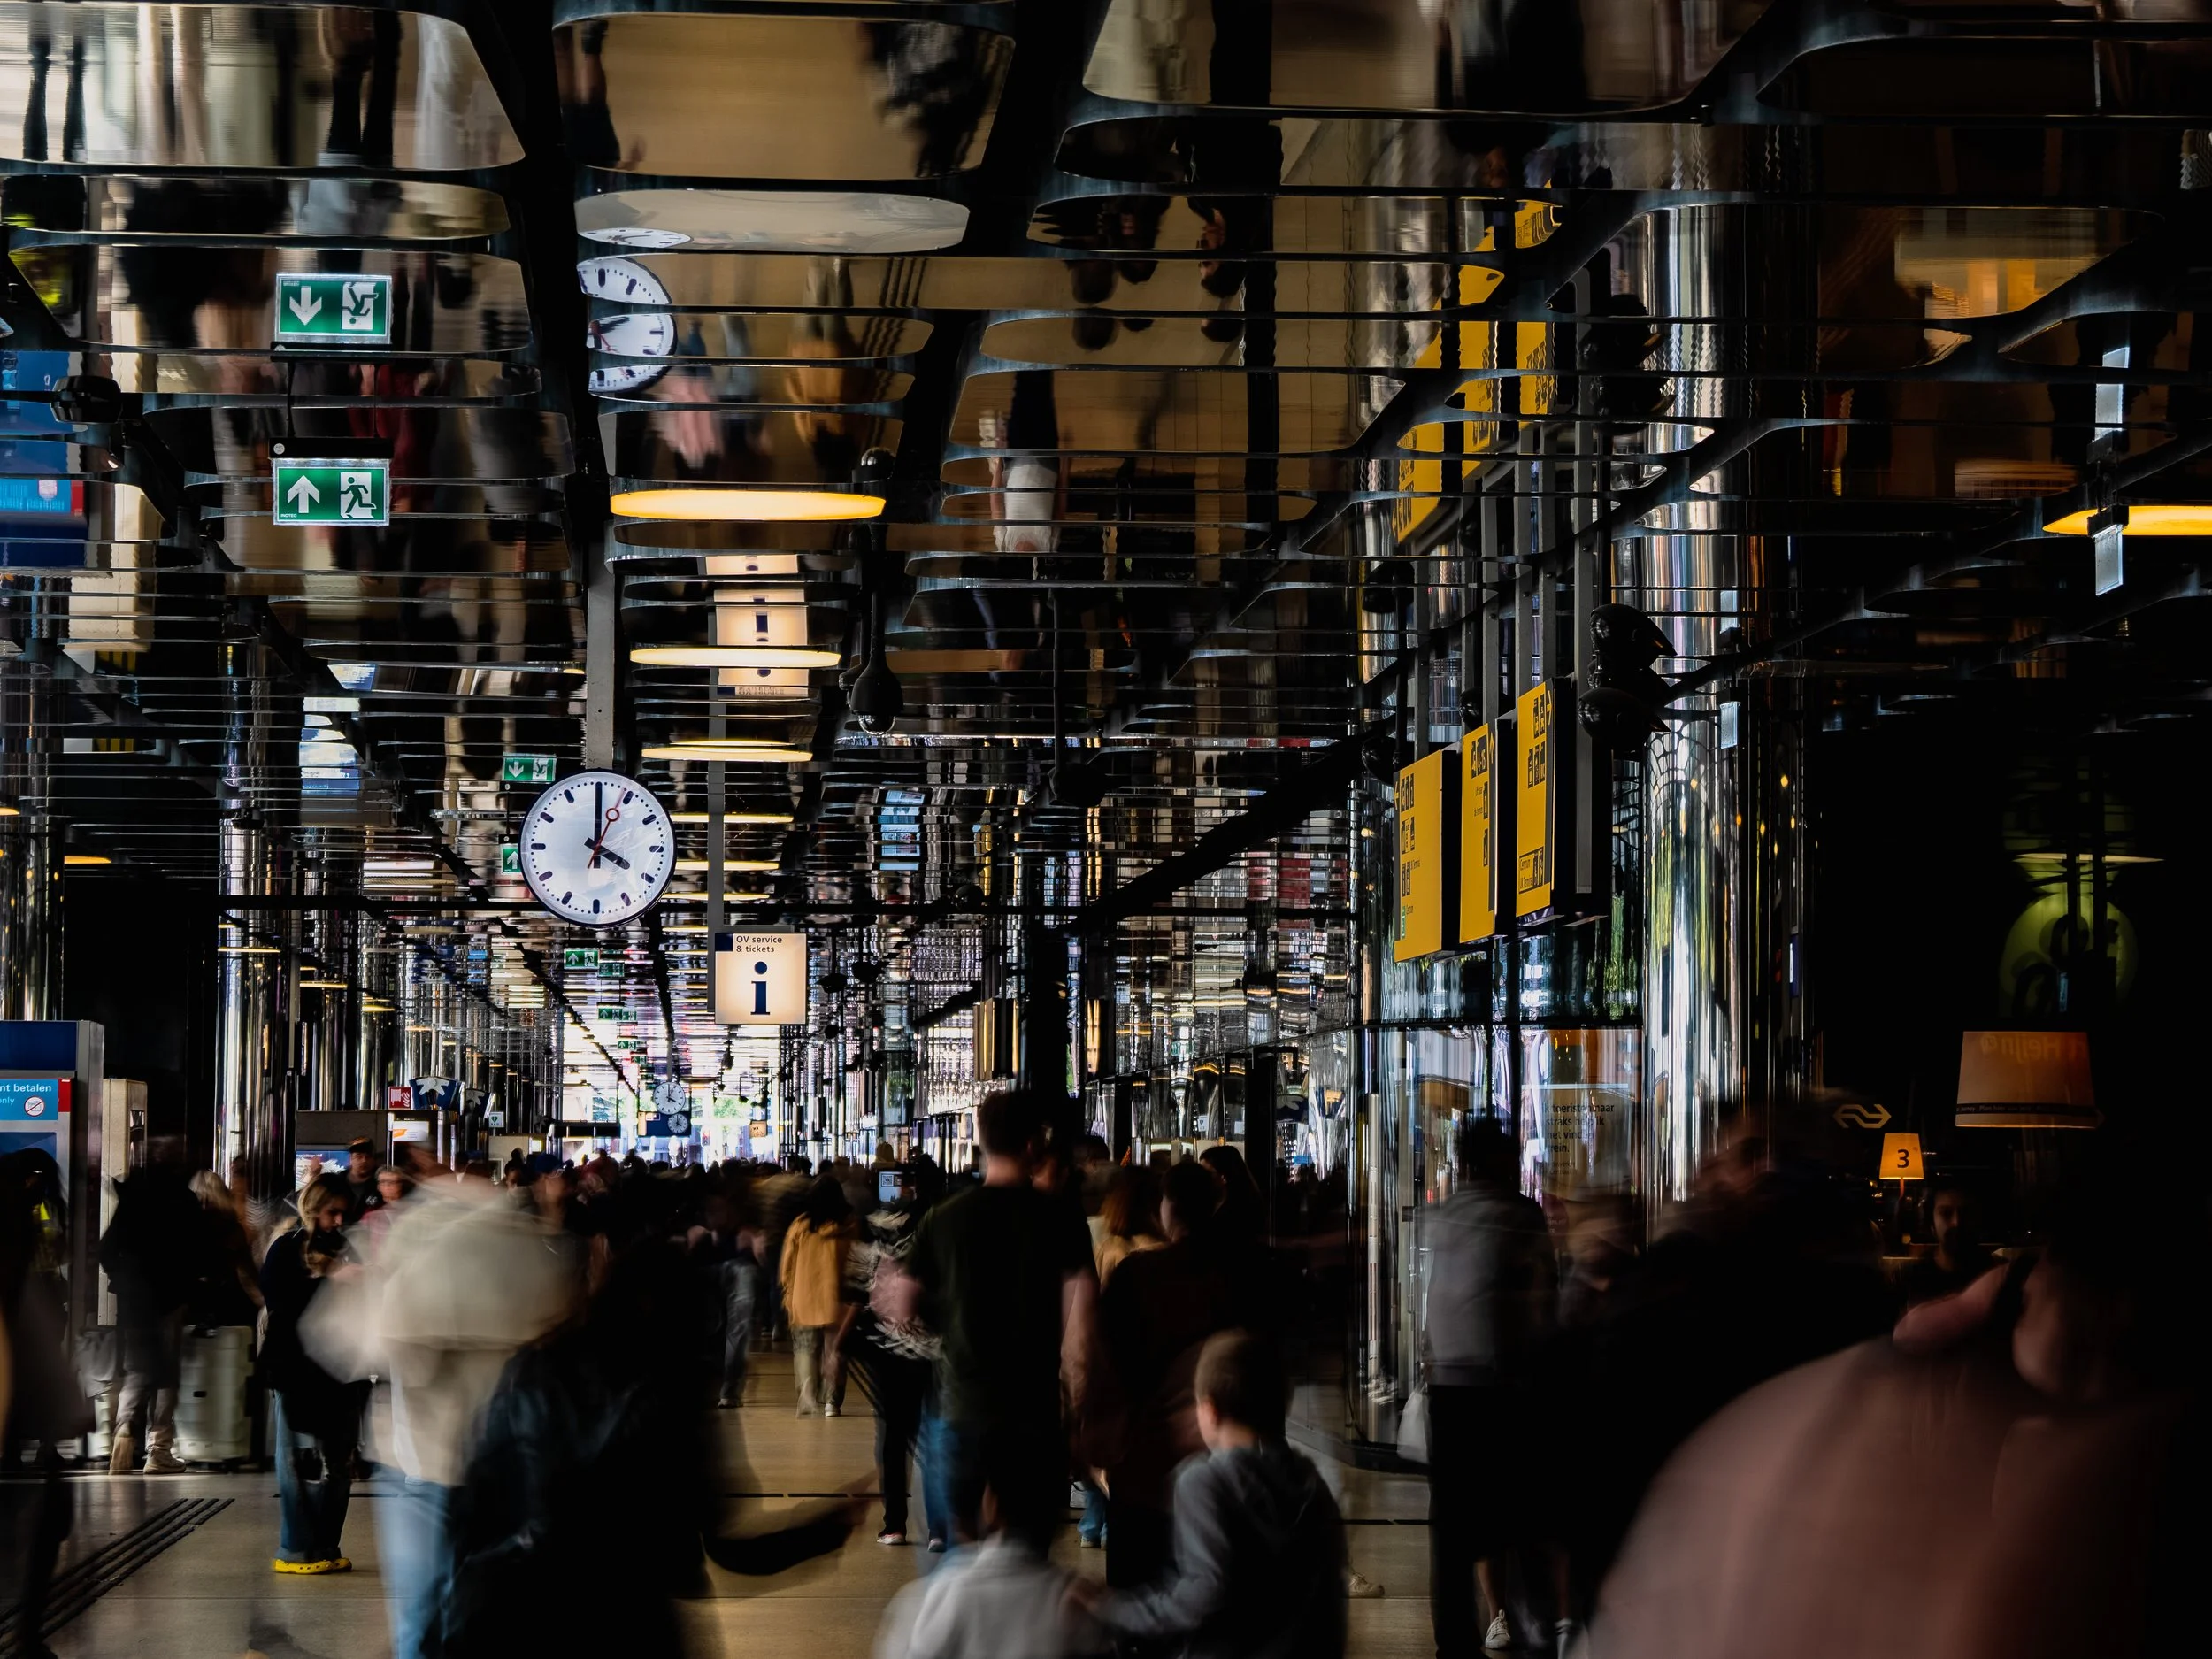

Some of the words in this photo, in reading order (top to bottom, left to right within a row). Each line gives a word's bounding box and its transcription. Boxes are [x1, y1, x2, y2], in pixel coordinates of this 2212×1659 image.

[1547, 1116, 1572, 1125] straks
[1563, 1130, 1594, 1140] vindn
[1897, 1149, 1909, 1169] 3
